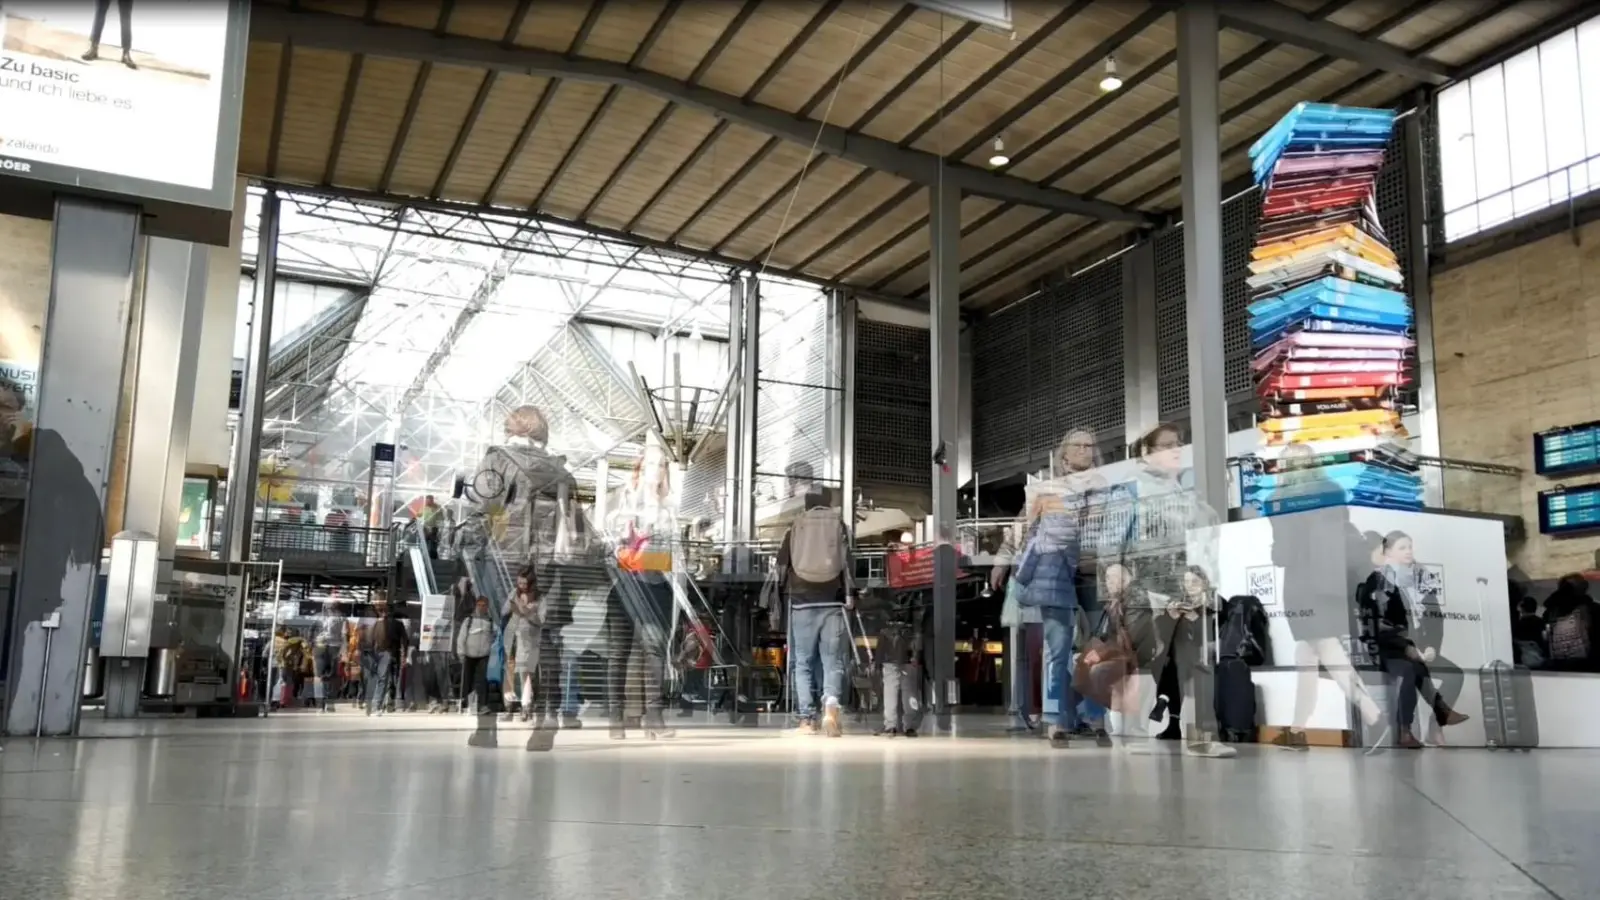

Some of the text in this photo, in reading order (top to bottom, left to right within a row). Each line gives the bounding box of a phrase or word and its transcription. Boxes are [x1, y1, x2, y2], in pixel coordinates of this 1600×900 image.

[0, 56, 80, 83] Zu basic
[0, 76, 33, 92] und
[38, 82, 63, 97] ich
[68, 85, 108, 104] liebe
[6, 139, 60, 154] zalando
